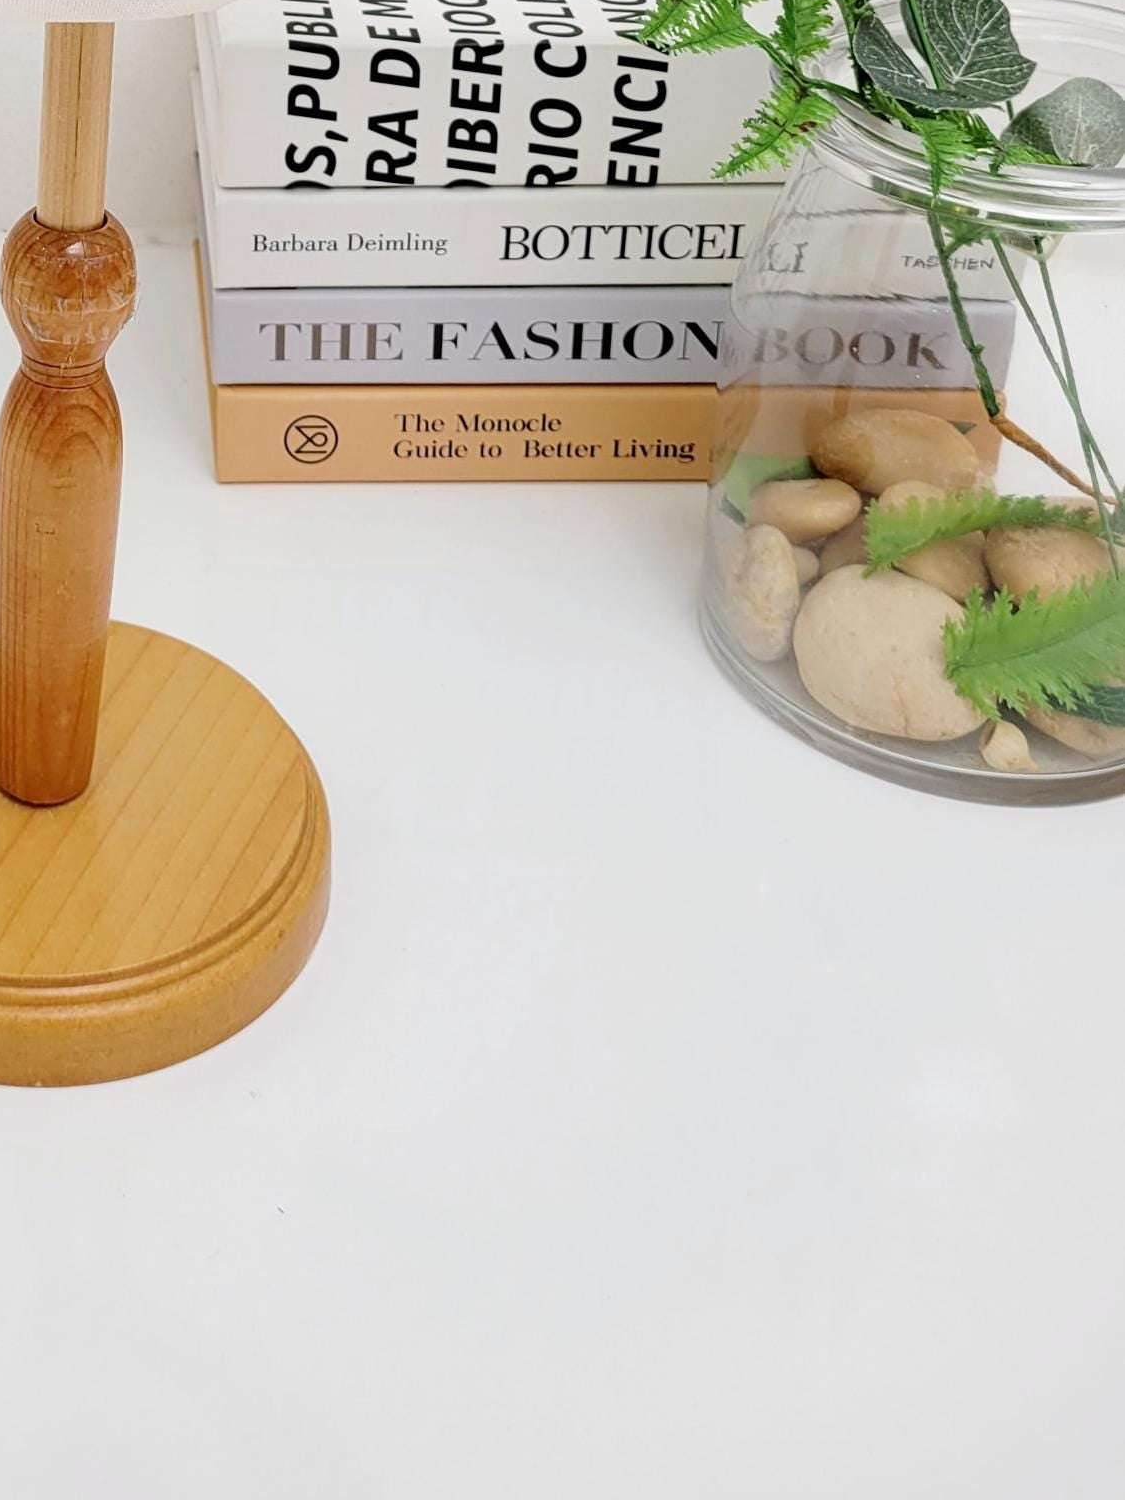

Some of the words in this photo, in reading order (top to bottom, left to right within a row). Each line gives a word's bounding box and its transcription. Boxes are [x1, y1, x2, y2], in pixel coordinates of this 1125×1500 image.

[366, 25, 422, 89] DE
[365, 109, 419, 186] RA
[525, 98, 583, 188] RIO
[252, 233, 338, 252] Barbara
[347, 232, 449, 256] Deimling
[901, 254, 996, 270] TASHEN
[258, 321, 404, 362] THE
[425, 320, 725, 361] FASHON
[753, 325, 952, 371] BOOK
[394, 413, 445, 433] The
[455, 412, 563, 433] Monocle
[392, 439, 469, 459] Guide
[479, 441, 503, 459] to
[524, 438, 602, 459] Better
[612, 437, 697, 464] Living
